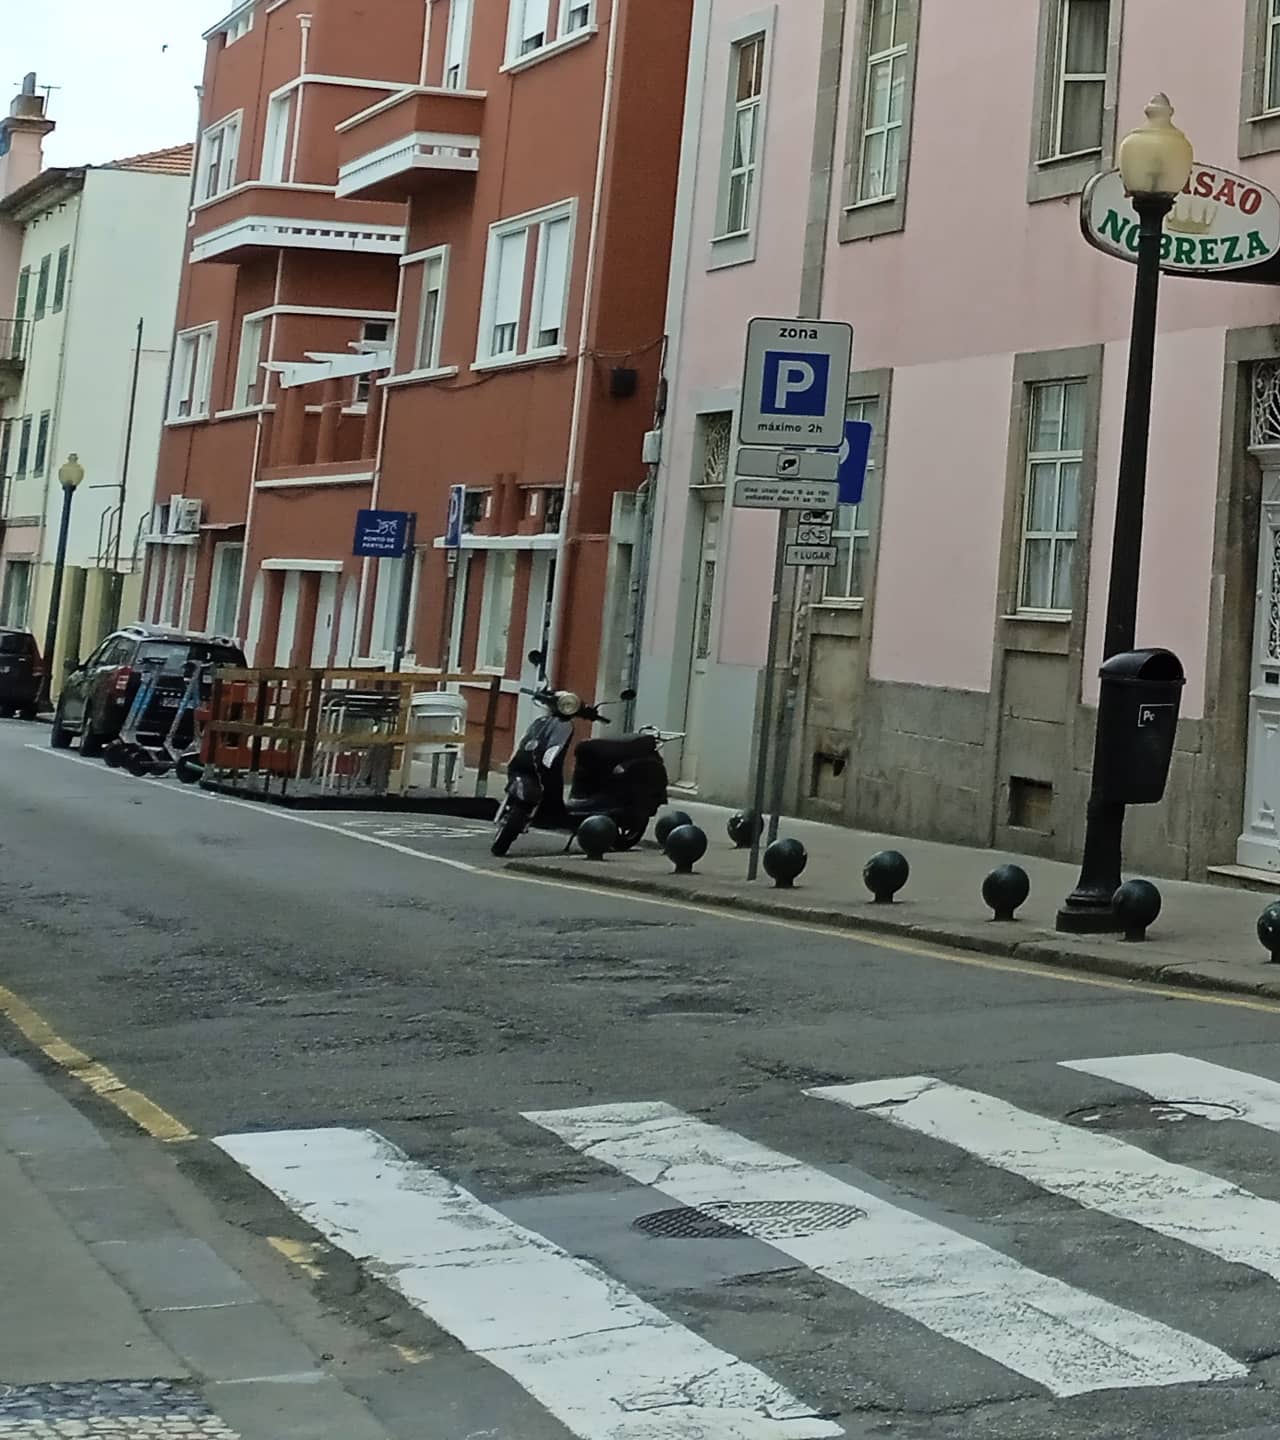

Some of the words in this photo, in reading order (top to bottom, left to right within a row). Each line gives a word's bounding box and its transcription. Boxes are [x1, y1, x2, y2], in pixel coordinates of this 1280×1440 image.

[778, 326, 818, 340] zona
[774, 359, 815, 409] P
[757, 421, 802, 434] máximo
[807, 423, 823, 434] 2h
[800, 551, 831, 560] LUGAR
